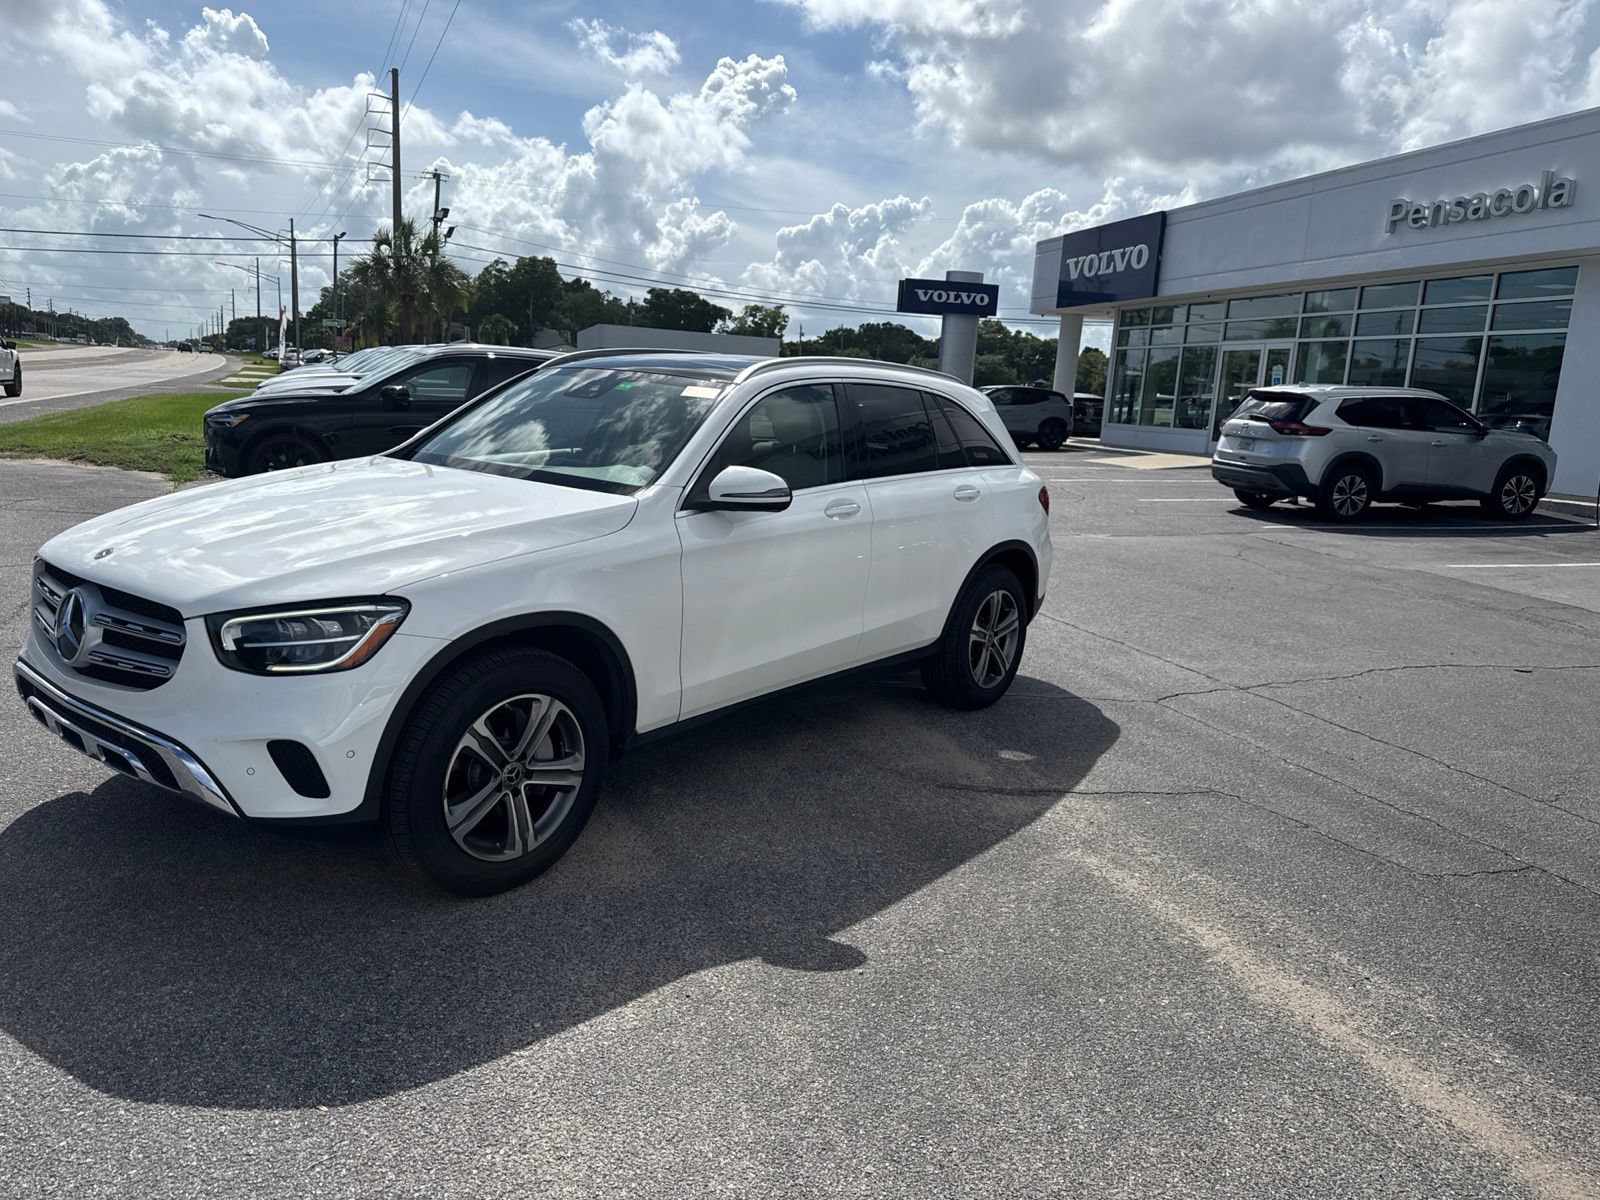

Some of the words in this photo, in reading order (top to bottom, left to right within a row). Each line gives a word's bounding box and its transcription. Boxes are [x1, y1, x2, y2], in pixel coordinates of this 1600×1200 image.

[1385, 169, 1577, 233] Pensacola
[1066, 244, 1149, 280] VOLVO
[914, 288, 990, 306] VOLVO
